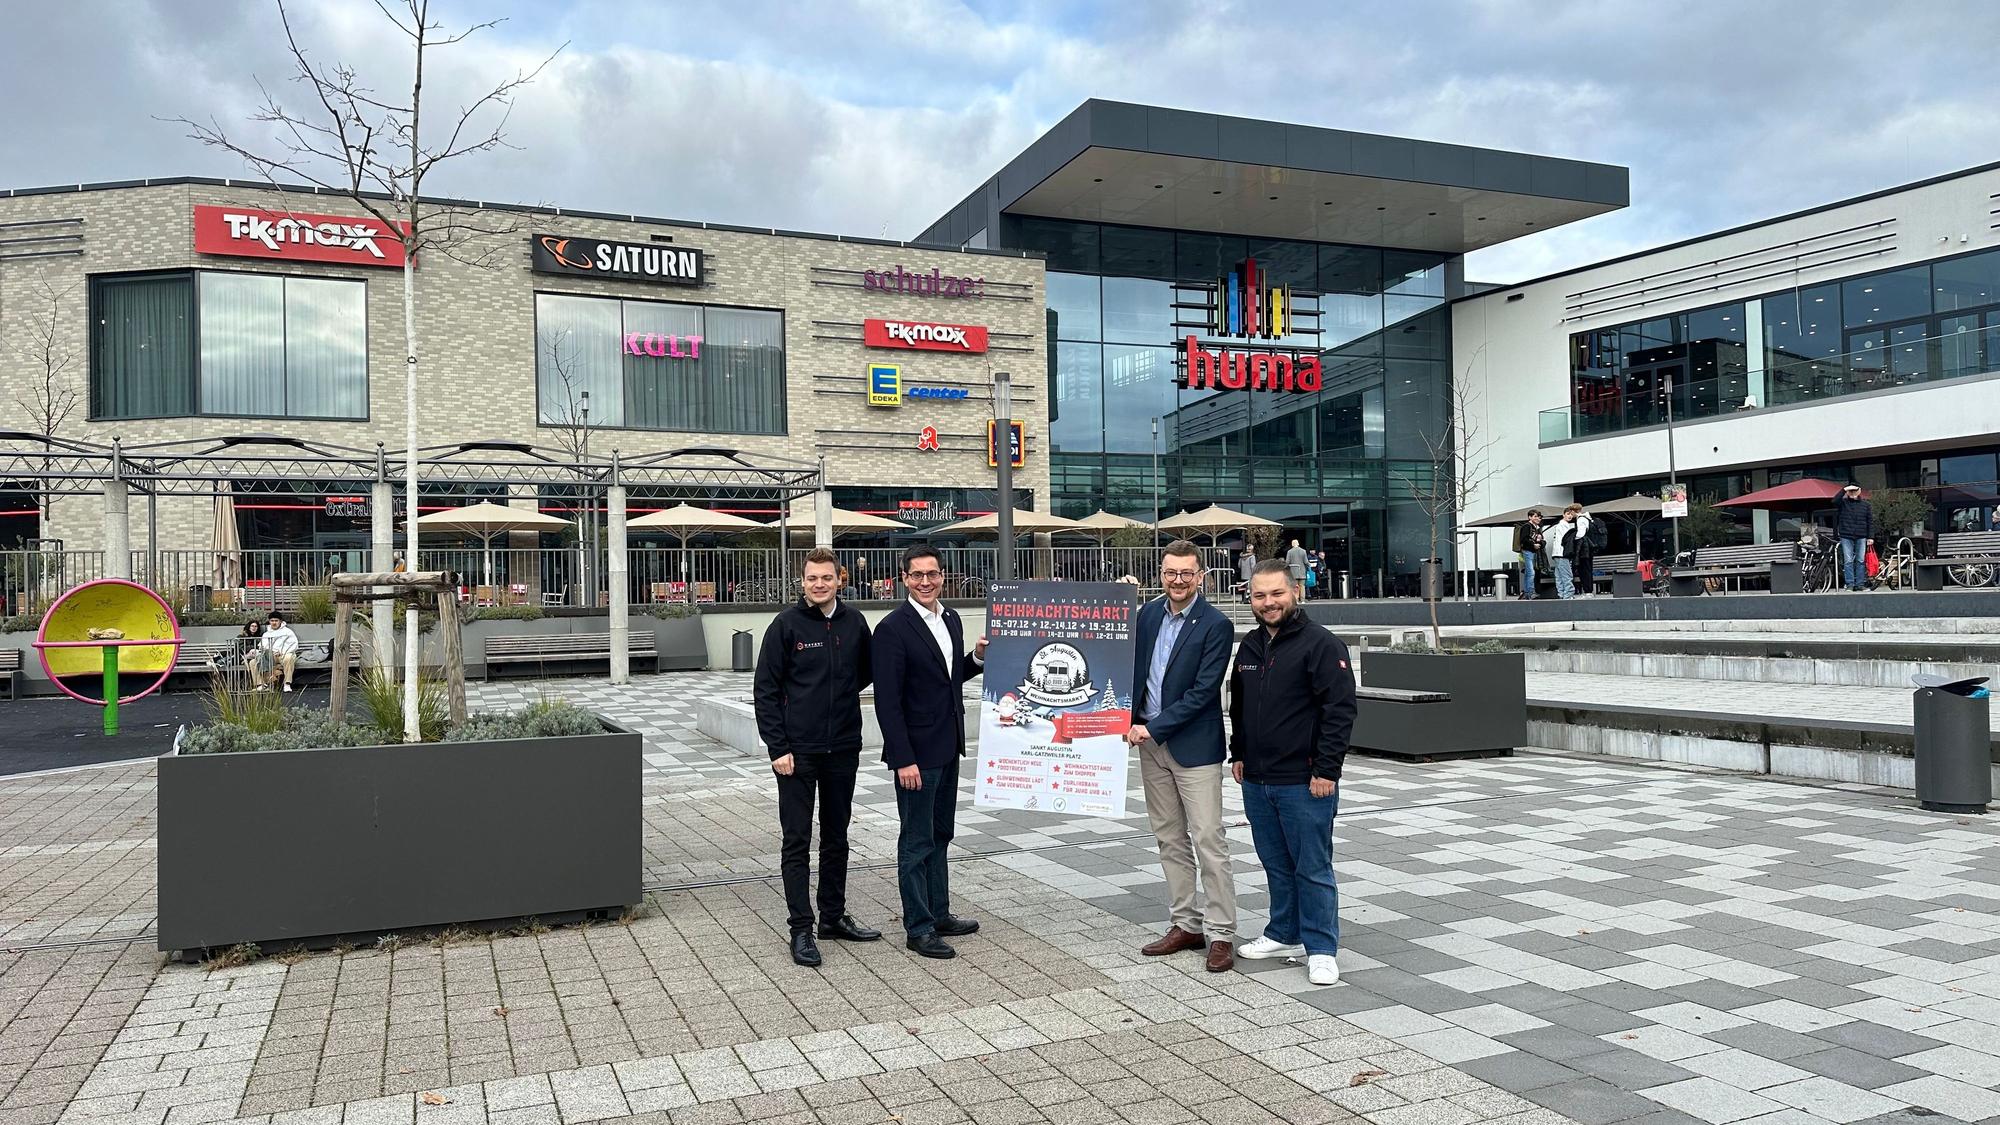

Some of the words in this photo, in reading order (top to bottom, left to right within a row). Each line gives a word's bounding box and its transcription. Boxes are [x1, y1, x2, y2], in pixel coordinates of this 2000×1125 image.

[596, 243, 697, 279] SATURN
[863, 264, 985, 298] schulze:
[624, 331, 704, 359] KULT
[1186, 335, 1322, 391] huma
[907, 386, 969, 401] center
[992, 603, 1130, 620] WEIHNACHTSMARKT
[991, 620, 1029, 628] 05.-07.12
[1040, 621, 1077, 629] 12.-14.12
[1030, 692, 1083, 703] WEIHNACHTSMARKT
